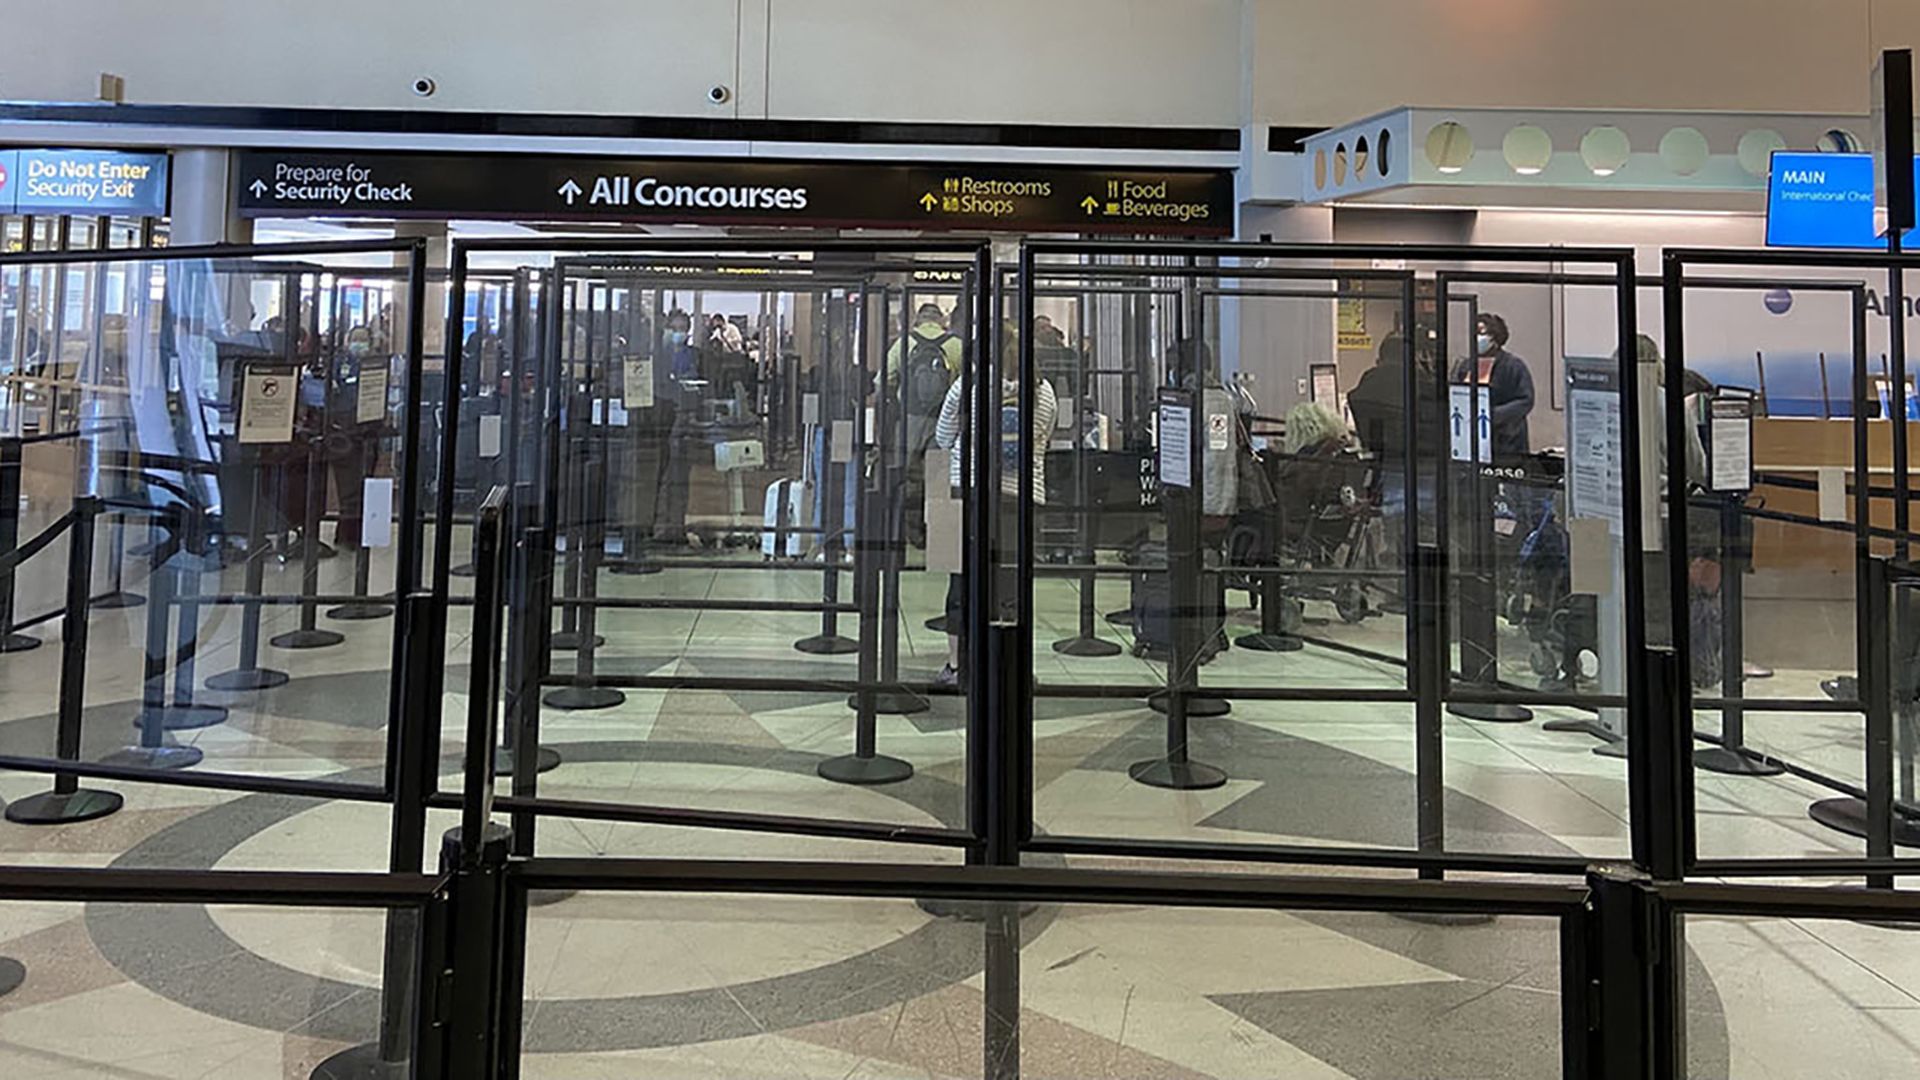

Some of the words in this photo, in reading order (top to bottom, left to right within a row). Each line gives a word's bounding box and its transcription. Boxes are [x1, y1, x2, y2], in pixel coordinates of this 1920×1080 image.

[28, 159, 57, 178] Do
[60, 160, 95, 179] Not
[99, 161, 150, 180] Enter
[275, 163, 343, 185] Prepare
[346, 163, 372, 182] for
[1782, 170, 1825, 184] MAIN
[27, 178, 99, 201] Security
[102, 180, 135, 198] Exit
[275, 182, 352, 204] Security
[354, 183, 413, 201] Check
[589, 176, 630, 205] All
[634, 178, 807, 209] Concourses
[962, 177, 1051, 196] Restrooms
[1123, 181, 1166, 198] Food
[1781, 190, 1846, 201] International
[962, 196, 1014, 216] Shops
[1123, 200, 1209, 222] Beverages
